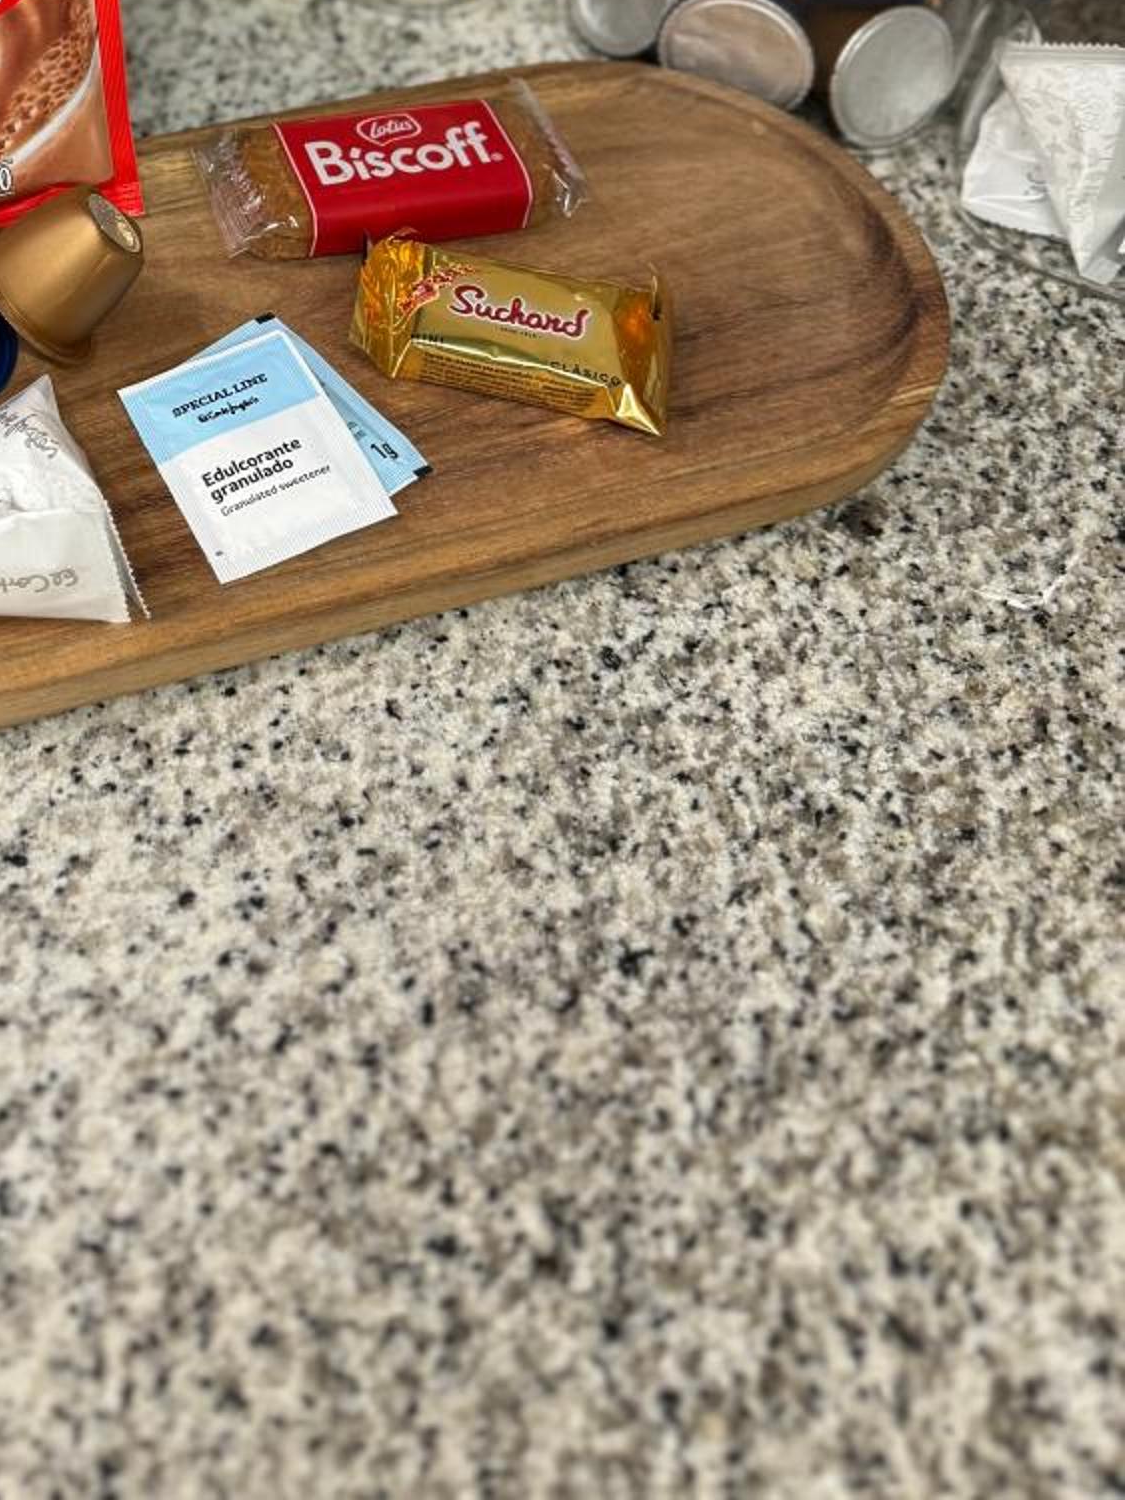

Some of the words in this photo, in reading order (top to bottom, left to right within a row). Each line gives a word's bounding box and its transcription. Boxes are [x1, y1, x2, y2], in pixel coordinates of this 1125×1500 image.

[369, 118, 414, 139] Lotus
[304, 120, 491, 186] Biscoff
[449, 285, 589, 337] Suchard
[172, 388, 234, 418] SPECIAL
[233, 373, 268, 395] LINE
[201, 438, 302, 488] Edulcorante
[370, 442, 399, 460] 1g
[210, 458, 294, 504] granulado
[220, 485, 278, 517] Granulated
[278, 464, 331, 491] sweetener
